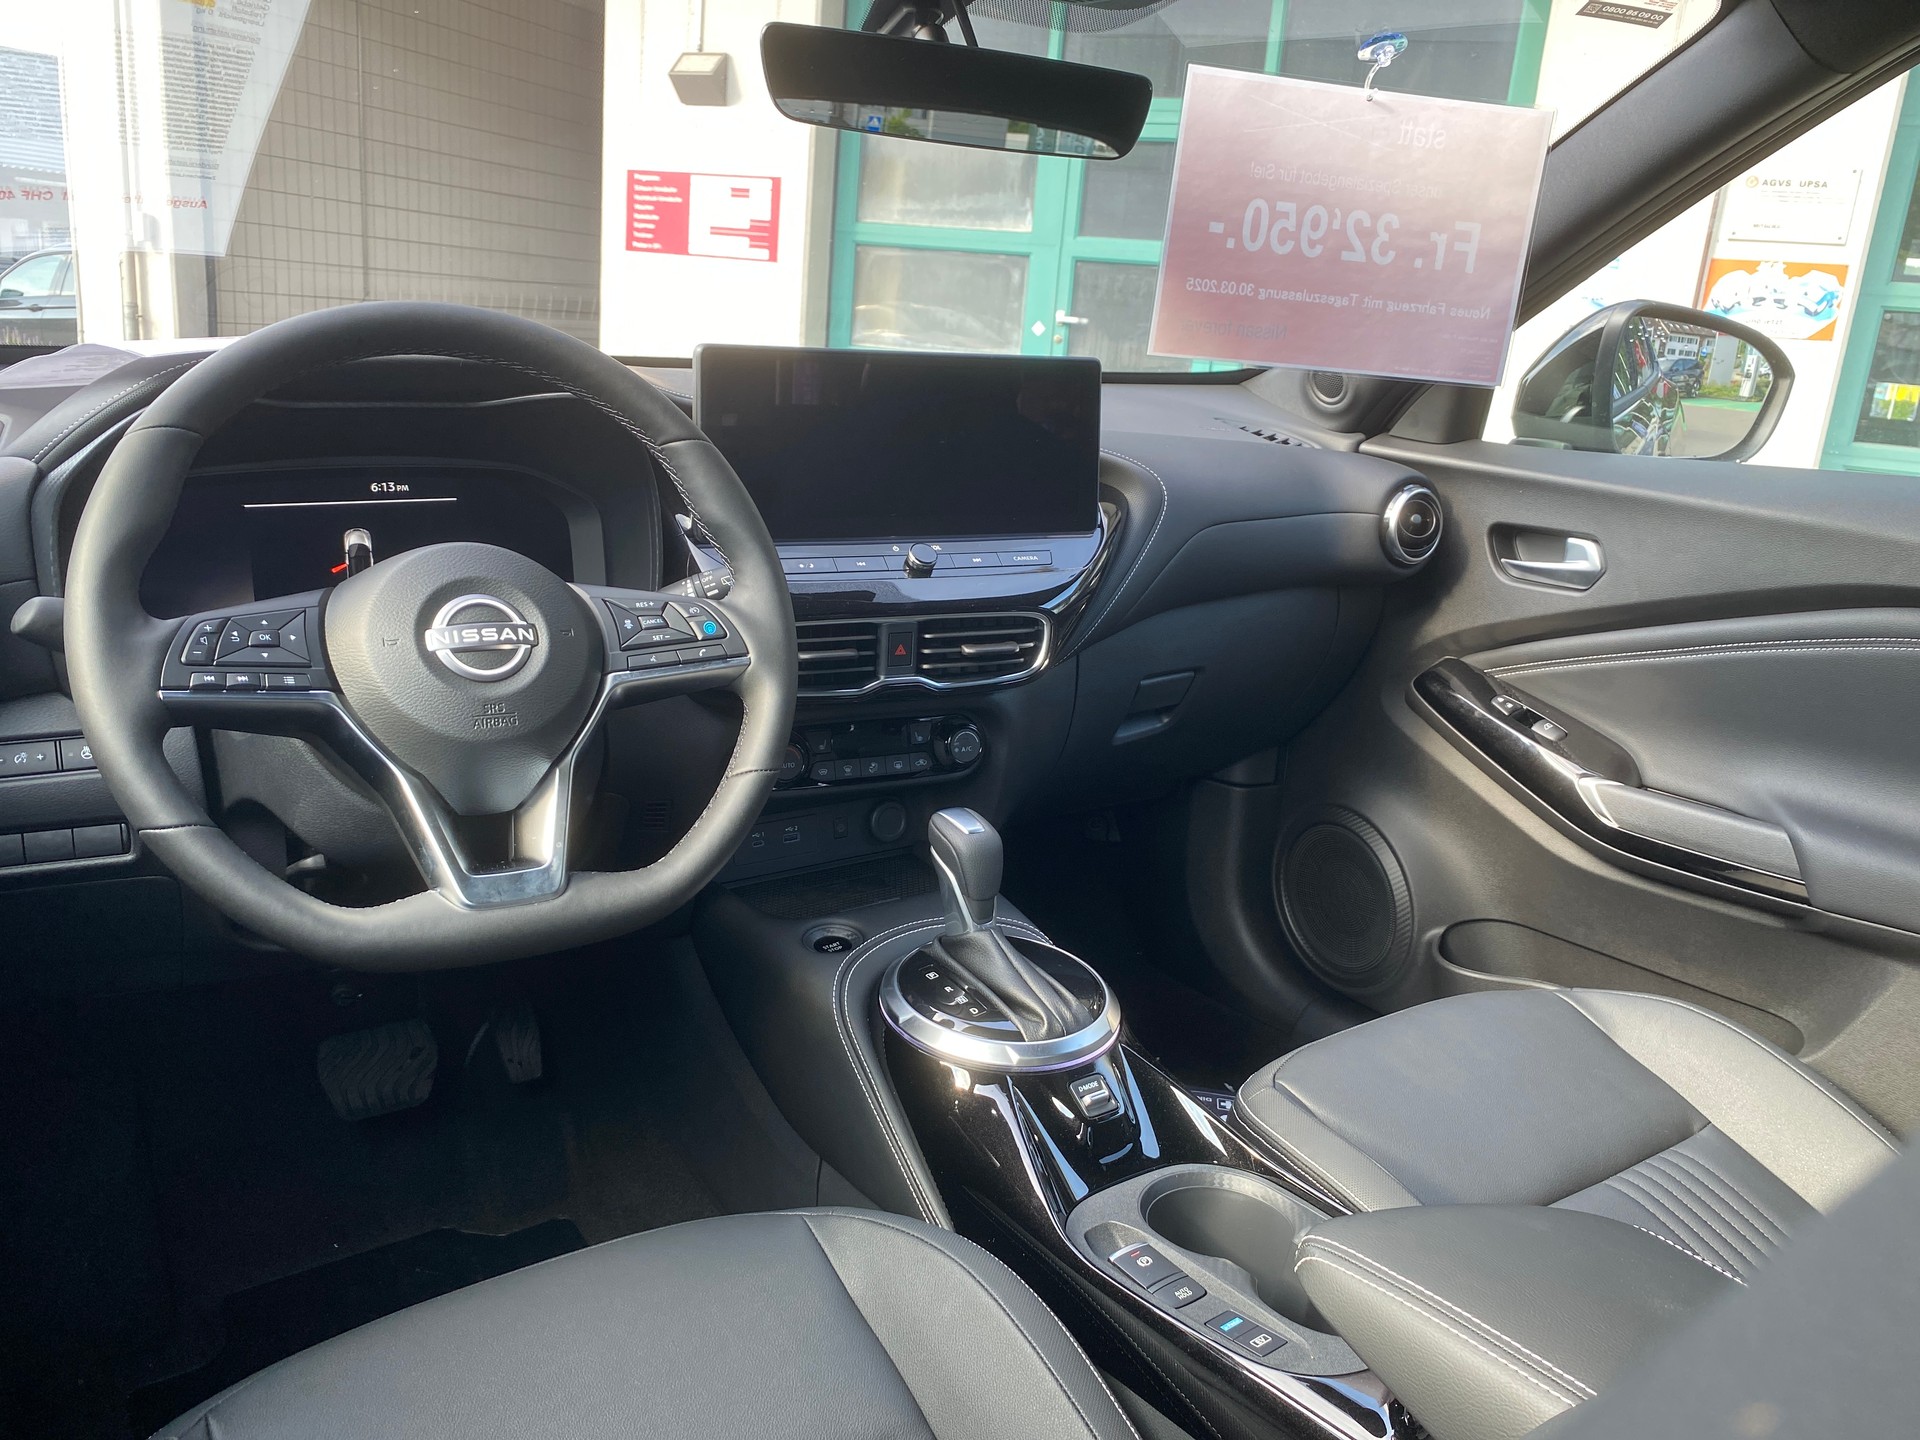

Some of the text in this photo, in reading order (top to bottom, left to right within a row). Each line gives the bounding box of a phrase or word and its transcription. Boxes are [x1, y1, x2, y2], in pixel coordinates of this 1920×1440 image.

[1602, 5, 1626, 14] 0800
[1762, 178, 1828, 189] AGVS UPSA
[370, 481, 410, 492] 6:13 PM
[1012, 554, 1039, 562] CAMERA
[701, 575, 713, 583] OFF
[642, 618, 663, 626] CANCEL
[258, 633, 272, 641] OK
[430, 626, 534, 644] NISSAN
[483, 702, 506, 714] SRS
[473, 715, 519, 730] AIRBAG
[822, 941, 840, 950] START
[827, 945, 843, 953] STOP
[969, 1007, 979, 1015] D
[1174, 1286, 1189, 1297] AUTO
[1177, 1290, 1193, 1301] HOLD
